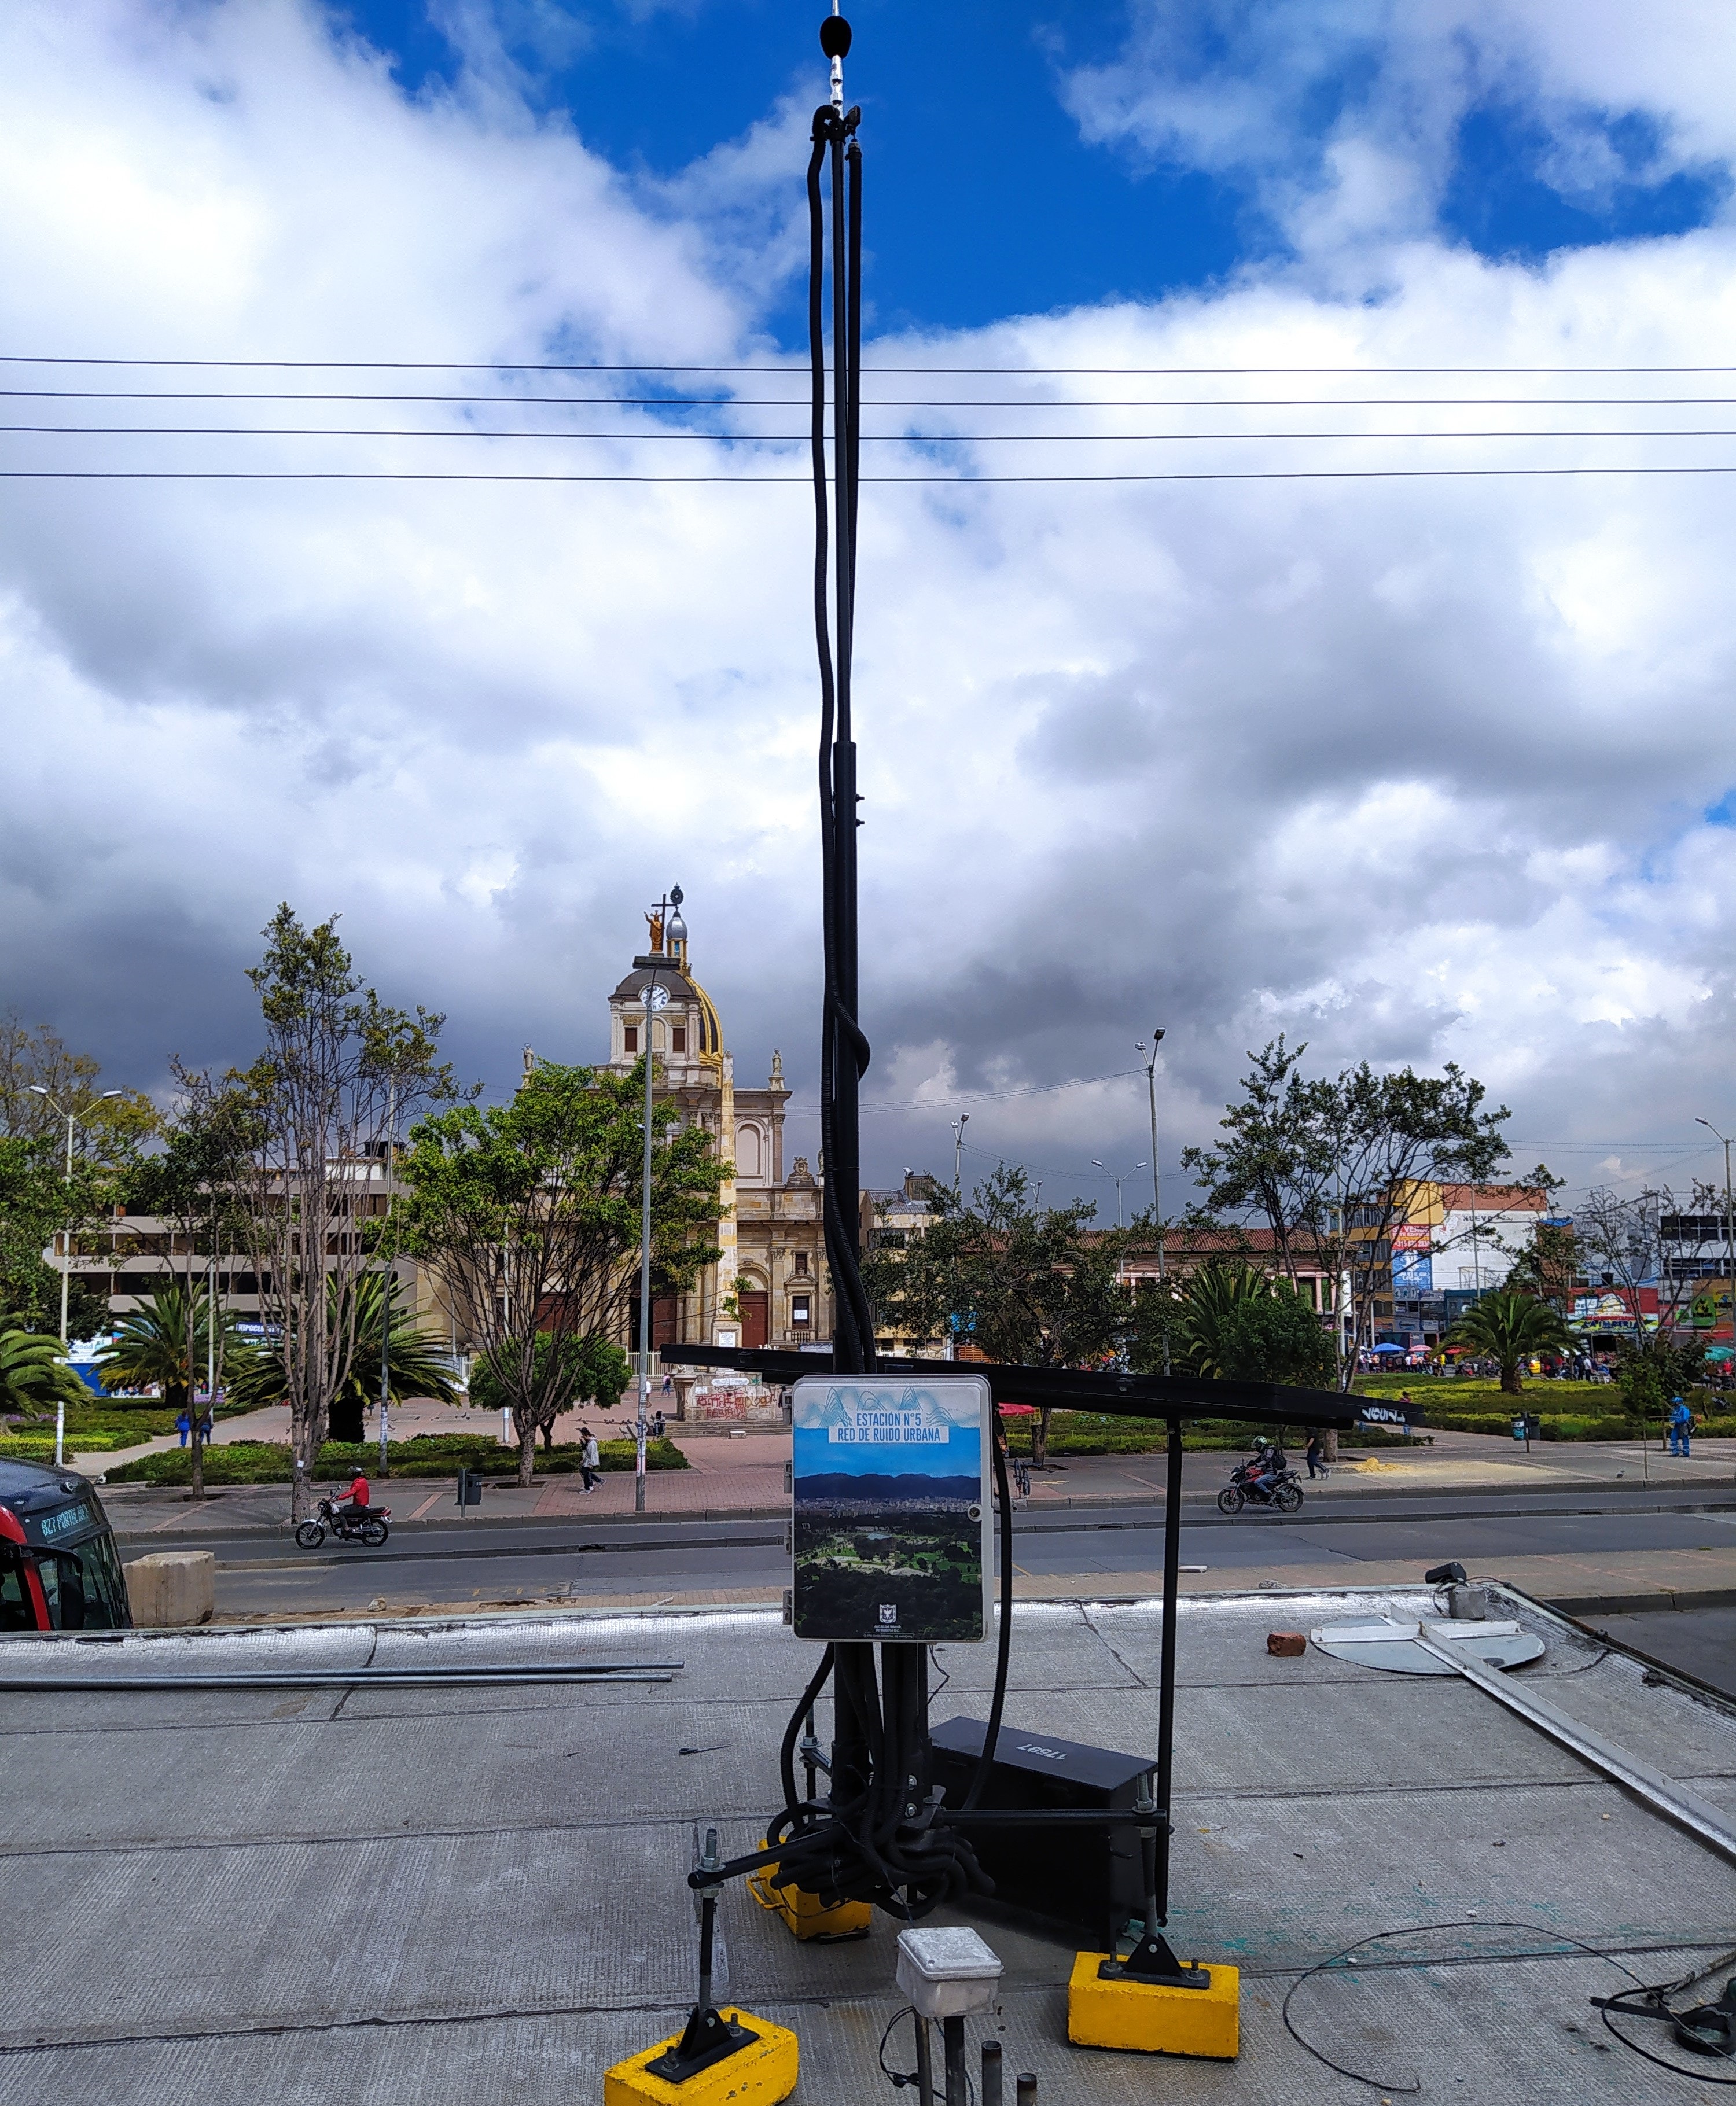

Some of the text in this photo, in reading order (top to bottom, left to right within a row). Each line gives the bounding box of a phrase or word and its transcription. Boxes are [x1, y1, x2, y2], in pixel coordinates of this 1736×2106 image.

[856, 1411, 921, 1426] ESTACIÓN N°5
[838, 1428, 941, 1441] RED DE RUIDO URBANA
[1015, 1743, 1068, 1760] 17597
